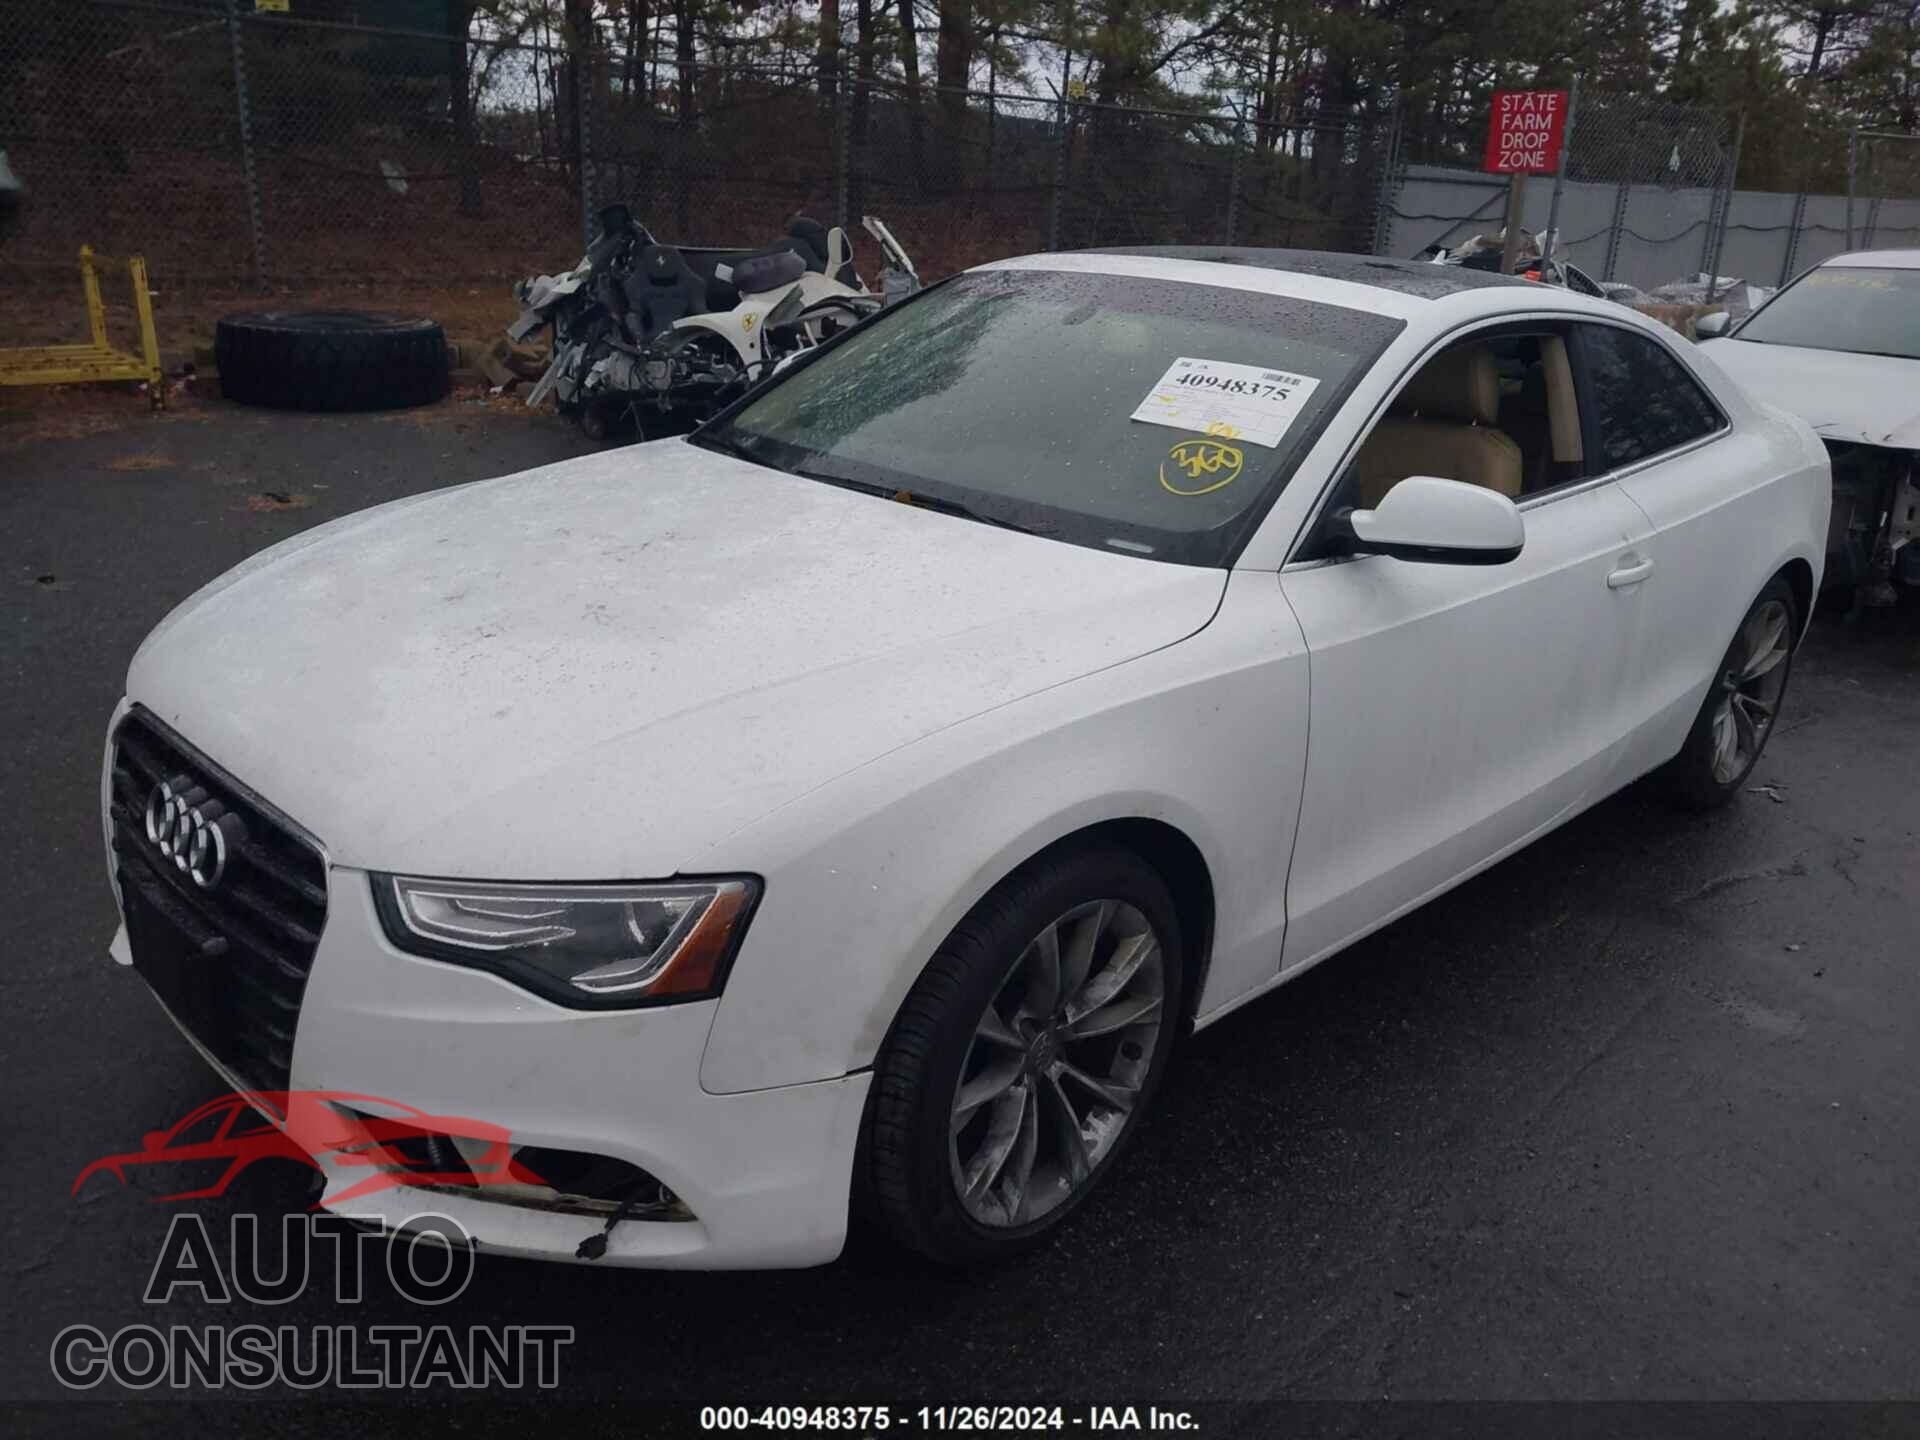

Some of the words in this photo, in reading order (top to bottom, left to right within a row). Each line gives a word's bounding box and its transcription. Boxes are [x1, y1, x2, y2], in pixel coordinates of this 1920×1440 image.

[1501, 92, 1558, 111] STATE
[1501, 113, 1553, 130] FARM
[1501, 132, 1550, 149] DROP
[1498, 151, 1546, 168] ZONE
[1176, 373, 1291, 401] 40948375
